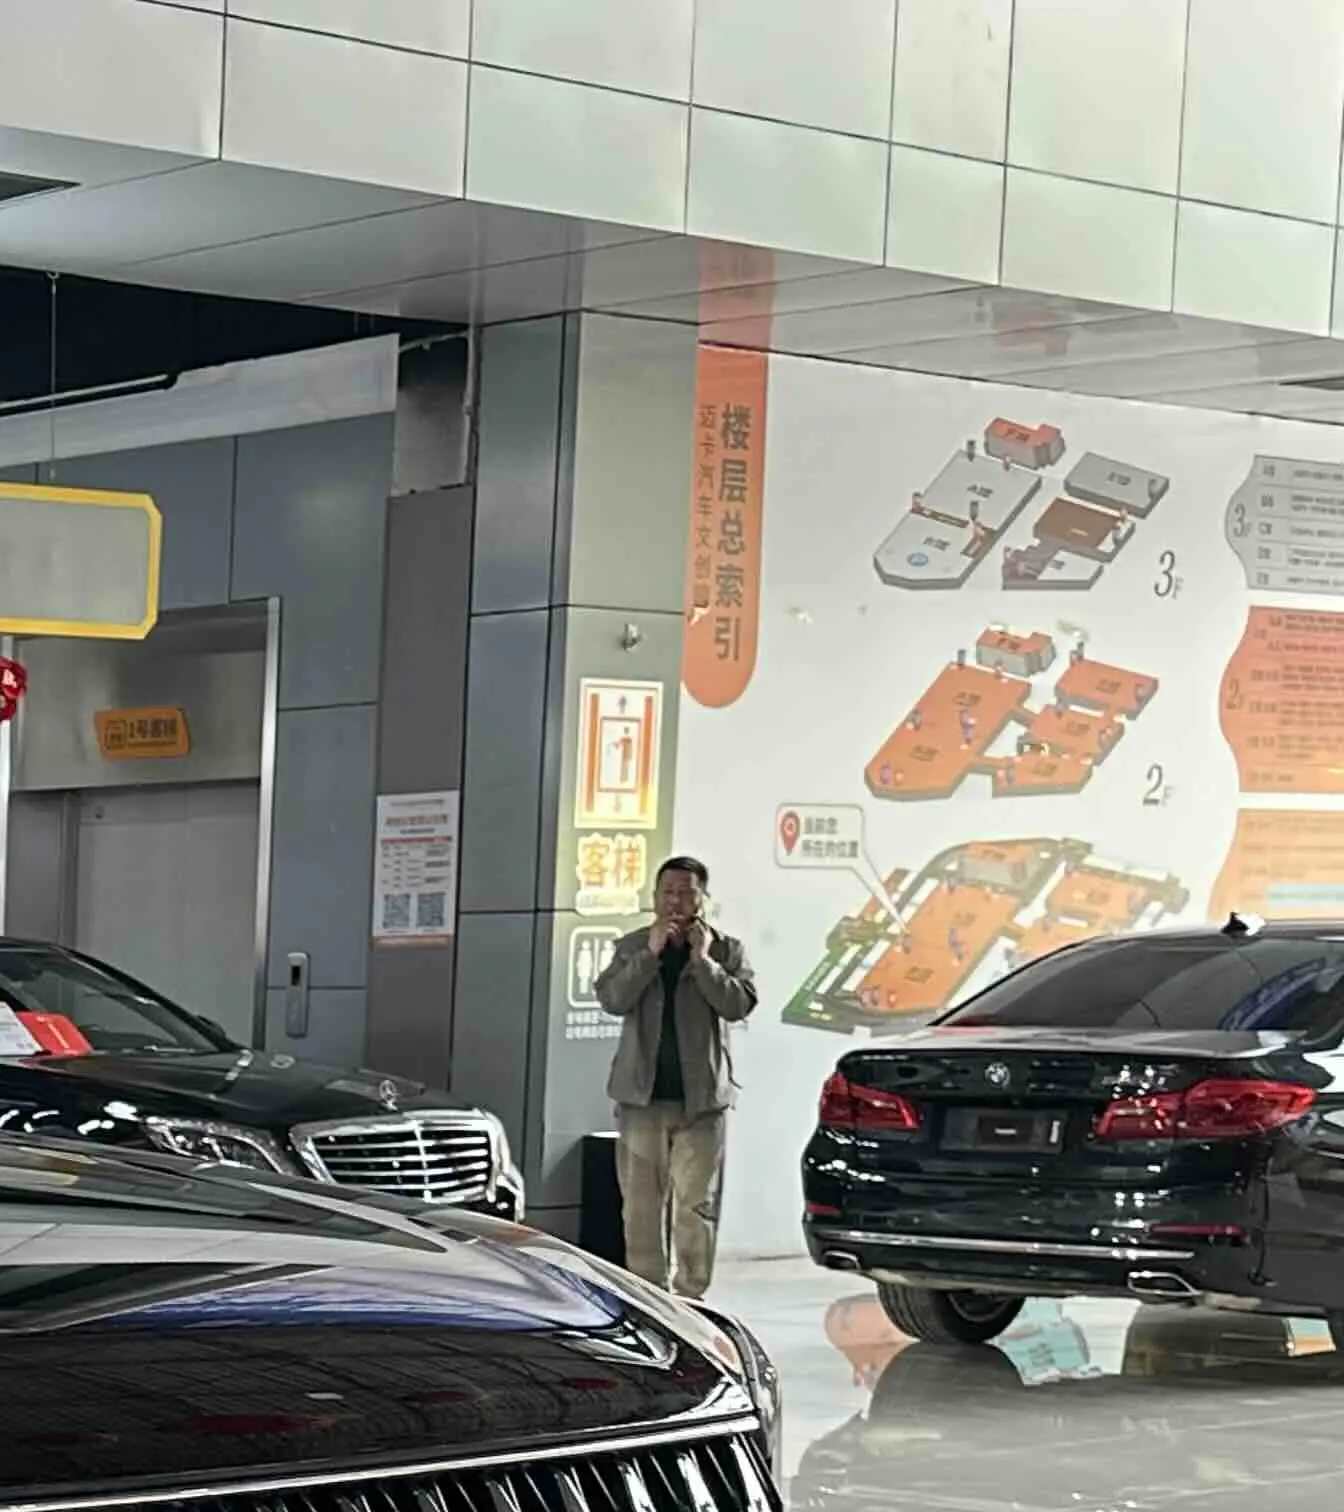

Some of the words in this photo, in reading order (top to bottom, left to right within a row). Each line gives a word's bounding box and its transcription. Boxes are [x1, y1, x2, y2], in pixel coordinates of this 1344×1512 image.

[714, 401, 752, 663] 楼层总索引
